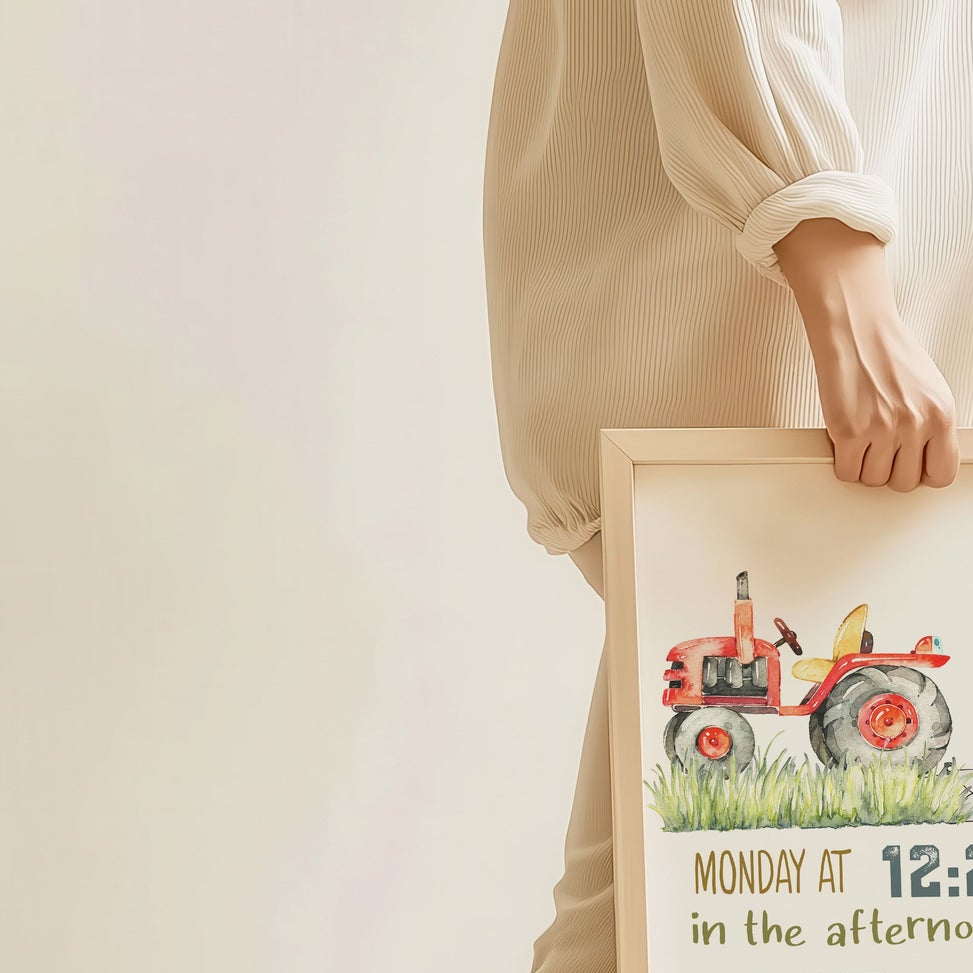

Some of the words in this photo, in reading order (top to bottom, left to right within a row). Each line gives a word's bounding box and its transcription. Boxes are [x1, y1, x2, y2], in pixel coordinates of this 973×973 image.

[694, 847, 806, 895] MONDAY
[818, 848, 852, 894] AT
[691, 911, 726, 946] in
[744, 909, 806, 947] the
